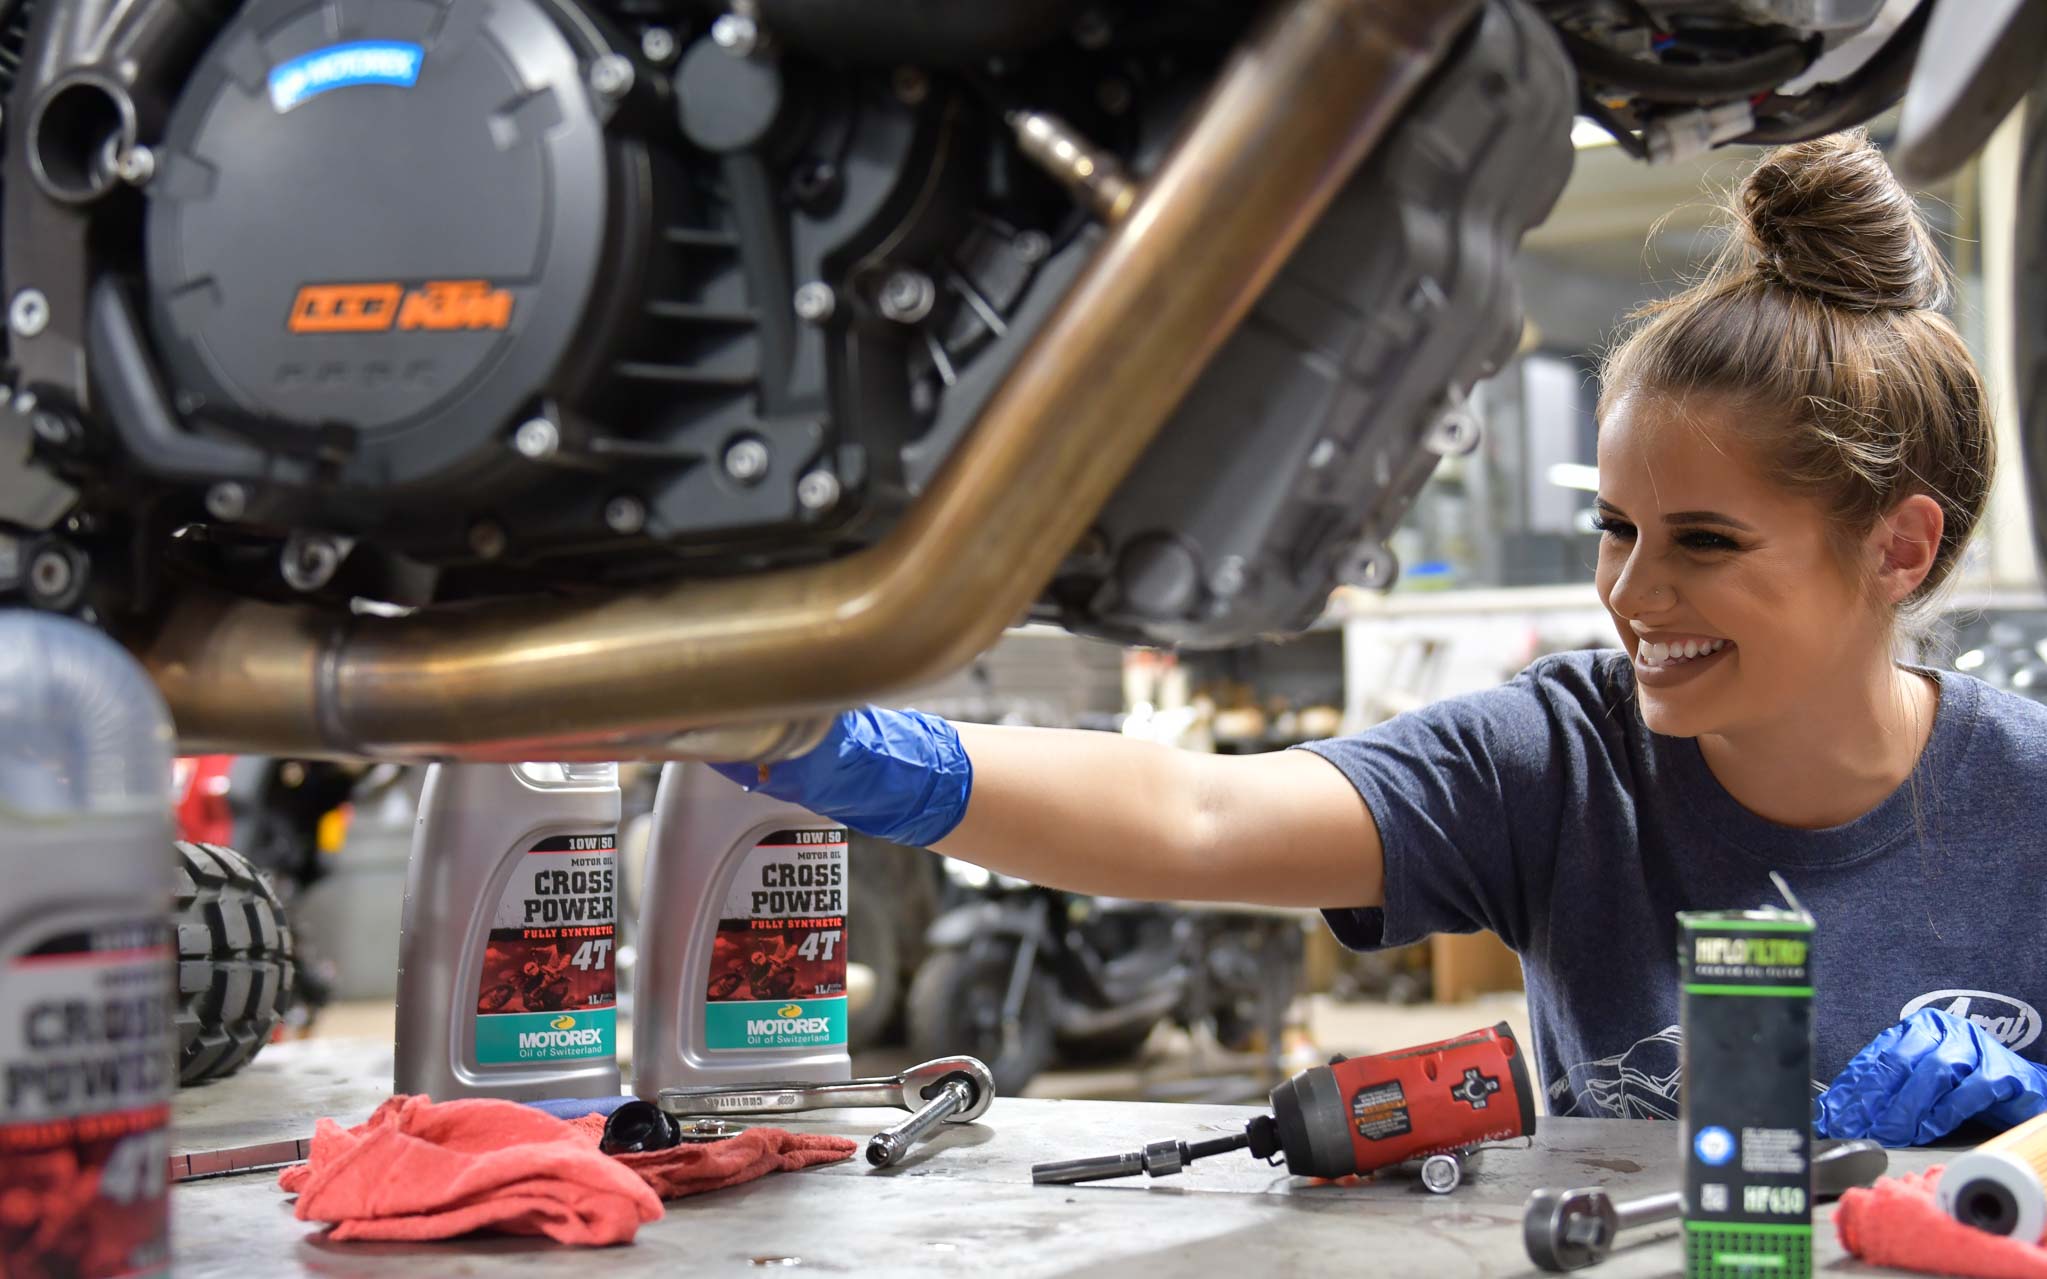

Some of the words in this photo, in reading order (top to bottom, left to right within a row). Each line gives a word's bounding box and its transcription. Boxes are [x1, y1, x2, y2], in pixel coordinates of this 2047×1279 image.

[399, 280, 514, 332] KTM
[571, 858, 601, 867] MOTOR
[603, 857, 613, 865] OIL
[798, 852, 828, 860] MOTOR
[830, 851, 841, 859] OIL
[534, 869, 613, 895] CROSS
[762, 863, 842, 888] CROSS
[524, 896, 614, 922] POWER
[751, 889, 842, 914] POWER
[523, 928, 557, 939] FULLY
[561, 925, 614, 938] SYNTHETIC
[752, 919, 785, 930] FULLY
[788, 917, 843, 929] SYNTHETIC
[571, 939, 612, 971] 4T
[798, 930, 841, 961] 4T
[747, 1017, 830, 1036] MOTOREX
[519, 1028, 602, 1049] MOTOREX
[747, 1036, 761, 1045] Oil
[764, 1035, 774, 1044] of
[777, 1033, 830, 1044] Switzerland
[519, 1048, 533, 1058] Oil
[537, 1047, 546, 1057] of
[550, 1045, 602, 1057] Switzerland
